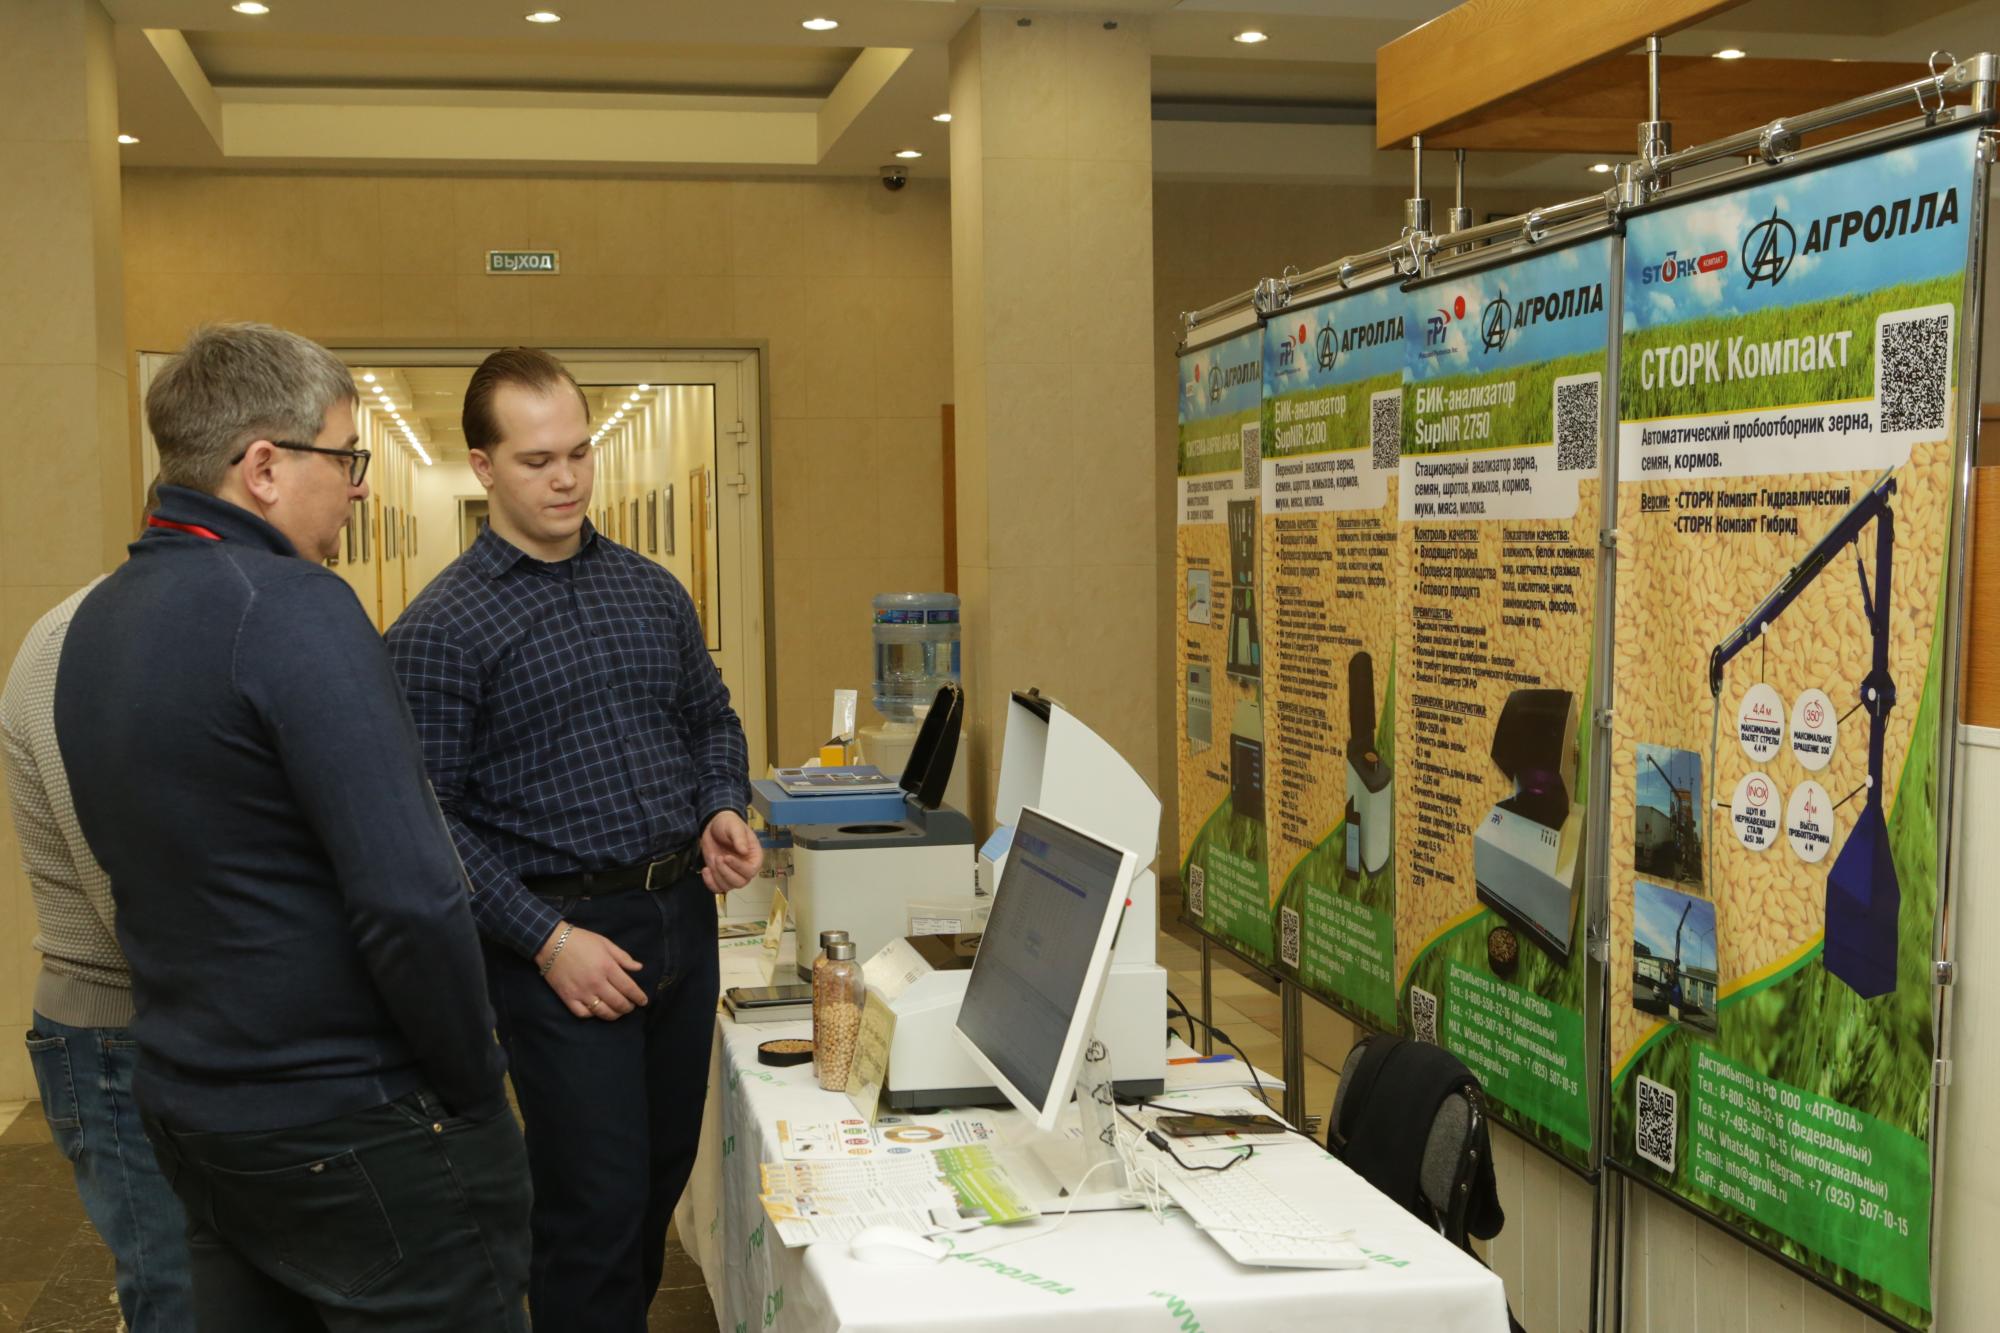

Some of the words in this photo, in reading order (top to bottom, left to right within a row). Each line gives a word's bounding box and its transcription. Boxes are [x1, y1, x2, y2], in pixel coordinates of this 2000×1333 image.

[1802, 187, 1959, 255] АГРОЛЛА
[493, 255, 552, 270] ВЫХОД
[1514, 283, 1604, 329] АГРОЛЛА
[1341, 316, 1404, 352] АГРОЛЛА
[1641, 339, 1721, 390] СТОРК
[1728, 331, 1853, 380] Компакт
[1223, 360, 1260, 388] АГРОЛЛА
[1416, 381, 1516, 413] БИК-анализатор
[1275, 395, 1346, 423] БИК-анализатор
[1275, 423, 1304, 452] SupNIR
[1306, 421, 1327, 445] 2300
[1416, 416, 1460, 449] SupNIR
[1463, 412, 1490, 440] 2750
[1641, 421, 1730, 445] Автоматический
[1733, 416, 1824, 442] пробоотборник
[1828, 412, 1873, 436] зерна,
[1306, 460, 1335, 474] анализатор
[1336, 459, 1355, 473] зерна,
[1415, 458, 1469, 478] Стационарный
[1472, 458, 1511, 474] анализатор
[1513, 456, 1538, 474] зерна,
[1641, 455, 1671, 472] семян,
[1674, 453, 1722, 472] кормов.
[1336, 476, 1359, 491] кормов,
[1415, 483, 1440, 498] семян,
[1443, 482, 1470, 497] шротов,
[1471, 480, 1500, 495] жмыхов,
[1502, 478, 1532, 495] кормов,
[1641, 493, 1670, 510] Версии:
[1717, 491, 1757, 508] Компакт
[1761, 487, 1850, 510] Гидравлический
[1414, 503, 1436, 518] муки,
[1438, 502, 1459, 517] мяса,
[1460, 501, 1486, 514] молока.
[1414, 527, 1447, 541] Контроль
[1449, 529, 1479, 540] качества:
[1716, 516, 1757, 533] Компакт
[1760, 515, 1798, 535] Гибрид
[1537, 530, 1569, 540] качества:
[1420, 545, 1458, 560] Входящего
[1420, 563, 1452, 579] Процесса
[1453, 566, 1497, 581] производства
[1420, 581, 1448, 597] Готового
[1450, 586, 1480, 600] продукта
[1741, 724, 1780, 736] МАКСИМАЛЬНЫЙ
[1741, 733, 1758, 743] ВЫЛЕТ
[1760, 735, 1779, 745] СТРЕЛЫ
[1794, 731, 1832, 744] МАКСИМАЛЬНОЕ
[1794, 742, 1819, 753] ВРАЩЕНИЕ
[1749, 786, 1767, 798] INOX
[1735, 814, 1776, 829] НЕРЖАВЕЮЩЕЙ
[1746, 807, 1758, 816] ЩУП
[1760, 809, 1766, 817] ИЗ
[1747, 826, 1763, 836] СТАЛИ
[1789, 828, 1829, 844] ПРОБООТБОРНИКА
[1800, 821, 1819, 832] ВЫСОТА
[1744, 834, 1754, 843] AISI
[1755, 837, 1764, 845] 304
[1450, 963, 1489, 993] Дистрибьютер
[1496, 983, 1507, 998] РФ
[1508, 988, 1520, 1004] ООО
[1450, 981, 1463, 998] Тел.:
[1450, 1000, 1463, 1017] Тел.:
[1532, 1061, 1548, 1081] (925)
[1549, 1070, 1578, 1096] 507-10-15
[1698, 1052, 1753, 1092] Дистрибьютер
[1756, 1081, 1760, 1094] в
[1763, 1082, 1777, 1101] РФ
[1781, 1090, 1801, 1111] ООО
[1805, 1102, 1863, 1133] «АГРОЛА»
[1698, 1074, 1718, 1097] Тел.:
[1720, 1084, 1784, 1129] 8-800-550-32-16
[1788, 1118, 1872, 1167] (федеральный)
[1698, 1096, 1717, 1120] Тел.:
[1720, 1110, 1787, 1156] +7-495-507-10-15
[1791, 1144, 1888, 1201] (многоканальный)
[1697, 1143, 1723, 1169] E-mail:
[1726, 1157, 1787, 1204] info@agrolla.ru
[1695, 1166, 1716, 1189] Сайт:
[1719, 1181, 1756, 1211] agrolla.ru
[1765, 1153, 1804, 1189] Telegram:
[1809, 1180, 1822, 1196] +7
[1826, 1185, 1855, 1213] (925)
[1859, 1198, 1908, 1237] 507-10-15
